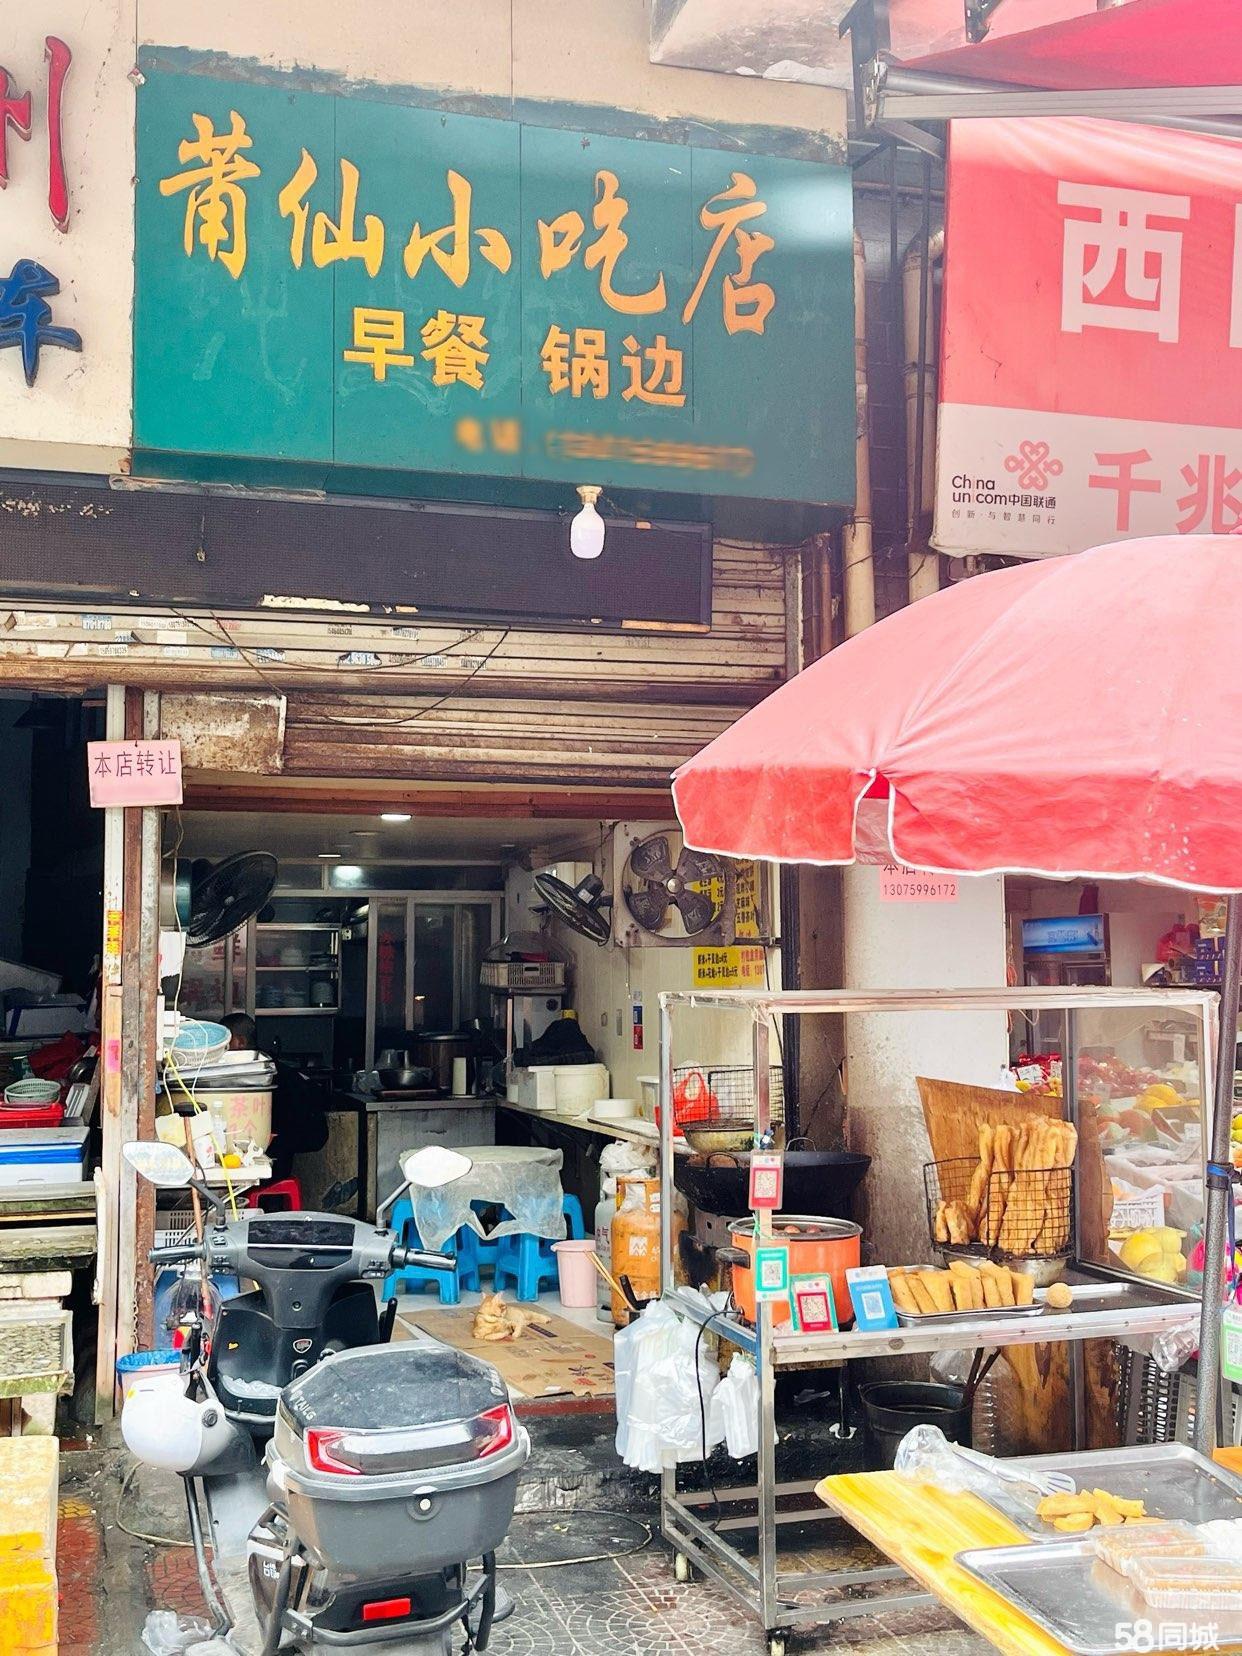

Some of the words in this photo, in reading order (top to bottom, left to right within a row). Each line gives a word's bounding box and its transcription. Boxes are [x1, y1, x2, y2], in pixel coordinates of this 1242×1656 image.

[160, 110, 777, 337] 莆仙小吃店
[1057, 180, 1242, 349] 西
[343, 307, 490, 391] 早餐
[540, 324, 687, 407] 锅边
[1088, 449, 1242, 534] 千兆
[94, 750, 177, 778] 本店转让
[883, 884, 957, 896] 13075996172
